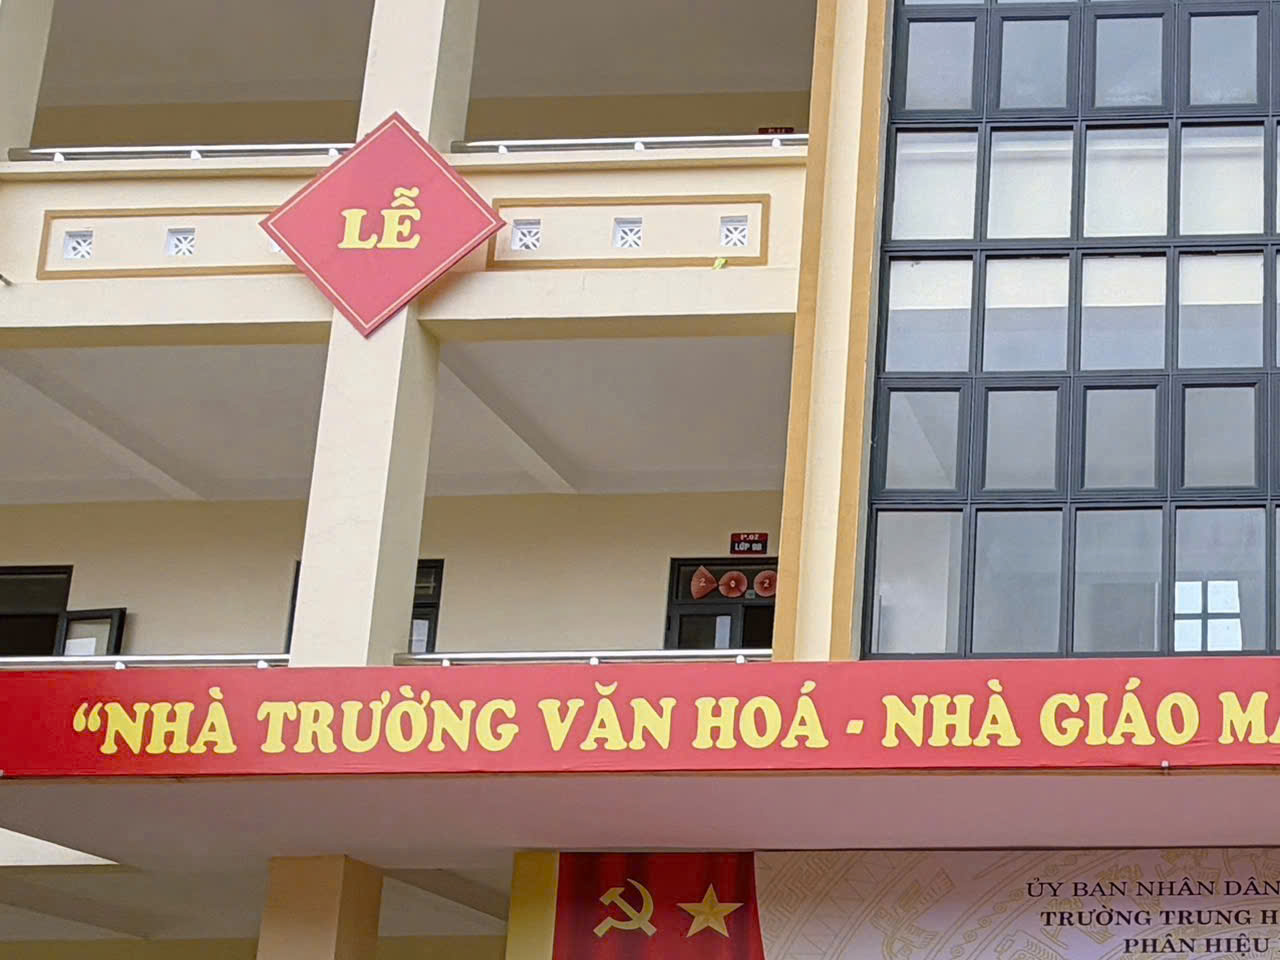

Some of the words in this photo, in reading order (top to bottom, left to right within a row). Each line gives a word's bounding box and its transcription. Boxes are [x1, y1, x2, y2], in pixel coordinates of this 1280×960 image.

[337, 187, 420, 249] LỄ
[73, 687, 236, 754] “NHÀ
[257, 685, 519, 753] TRƯỜNG
[540, 681, 676, 750] VĂN
[694, 680, 828, 749] HOÁ
[847, 720, 865, 734] -
[882, 679, 1020, 747] NHÀ
[1040, 677, 1200, 745] GIÁO
[1026, 877, 1064, 898] ỦY
[1072, 881, 1127, 897] BAN
[1135, 877, 1216, 896] NHÂN
[1223, 876, 1280, 896] DÂN
[1040, 905, 1152, 926] TRƯỜNG
[1159, 910, 1252, 926] TRUNG
[1124, 934, 1197, 954] PHÂN
[1205, 933, 1276, 957] HIỆU
